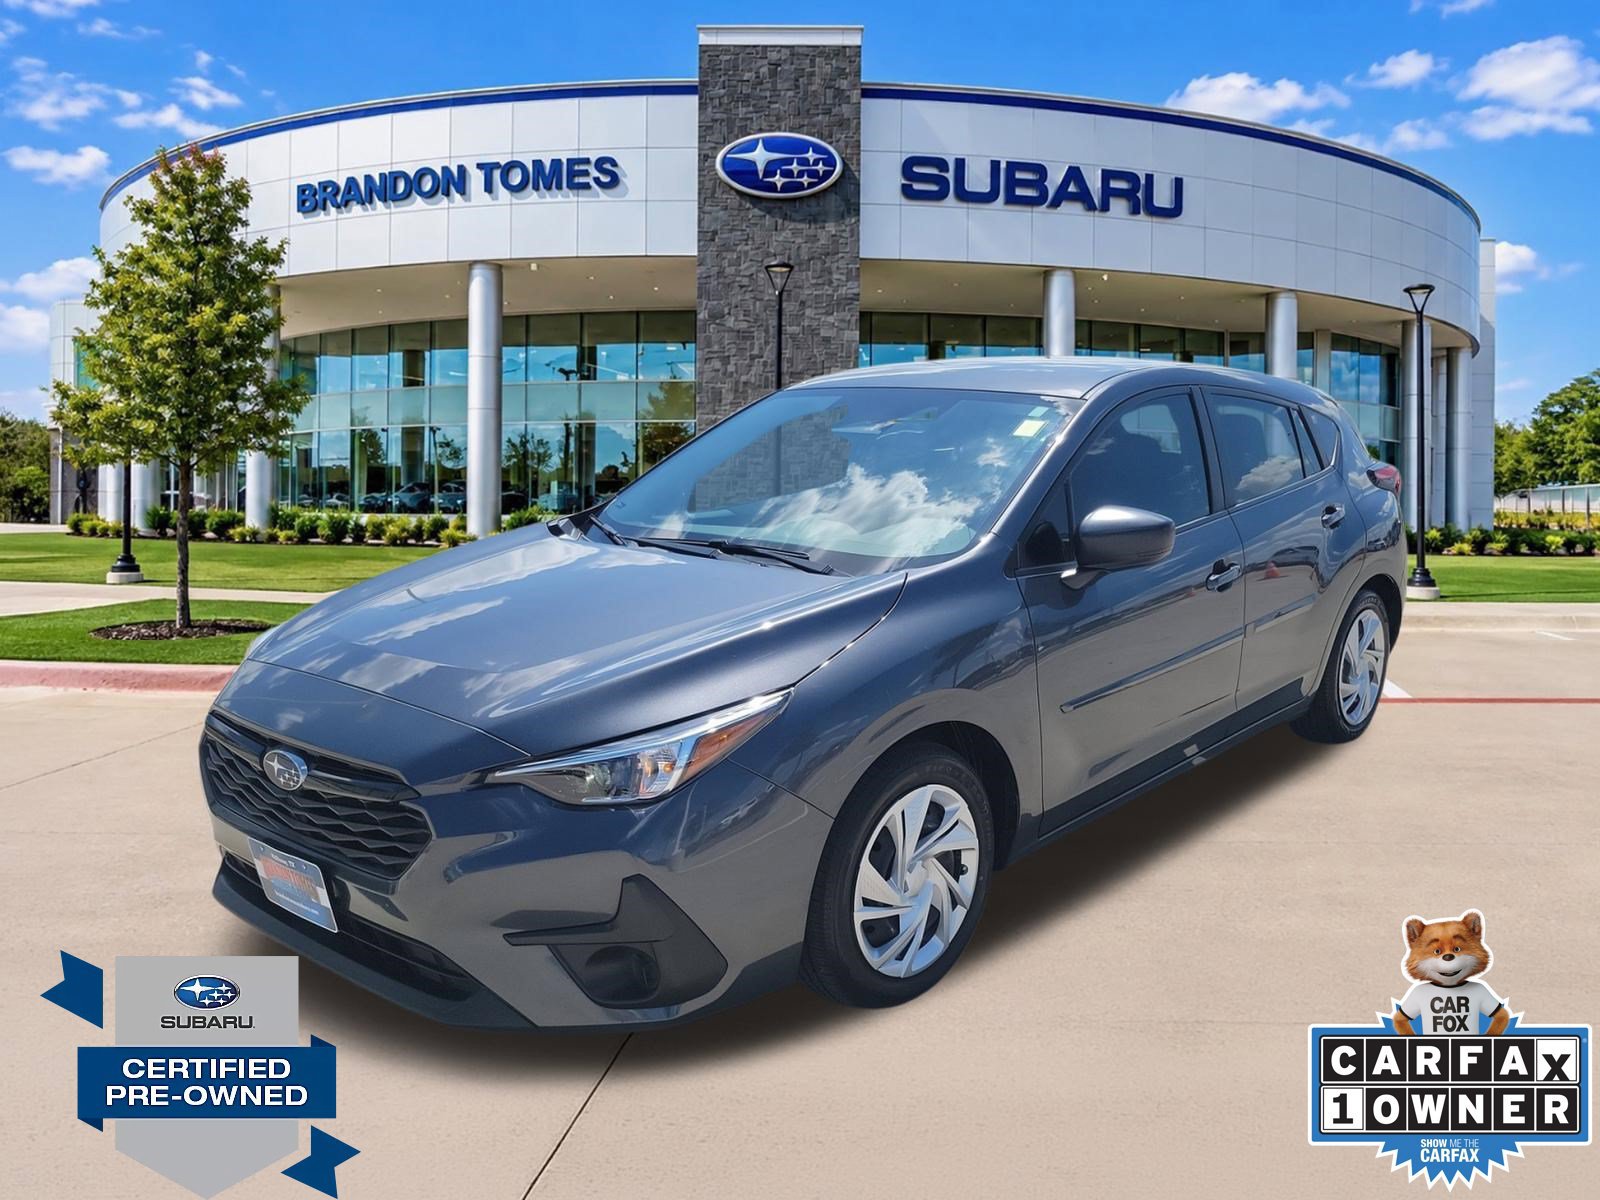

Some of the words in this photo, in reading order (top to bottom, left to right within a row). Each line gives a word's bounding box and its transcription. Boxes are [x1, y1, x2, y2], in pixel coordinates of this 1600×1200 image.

[297, 164, 467, 214] BRANDON
[476, 156, 621, 194] TOMES
[901, 155, 1184, 218] SUBARU
